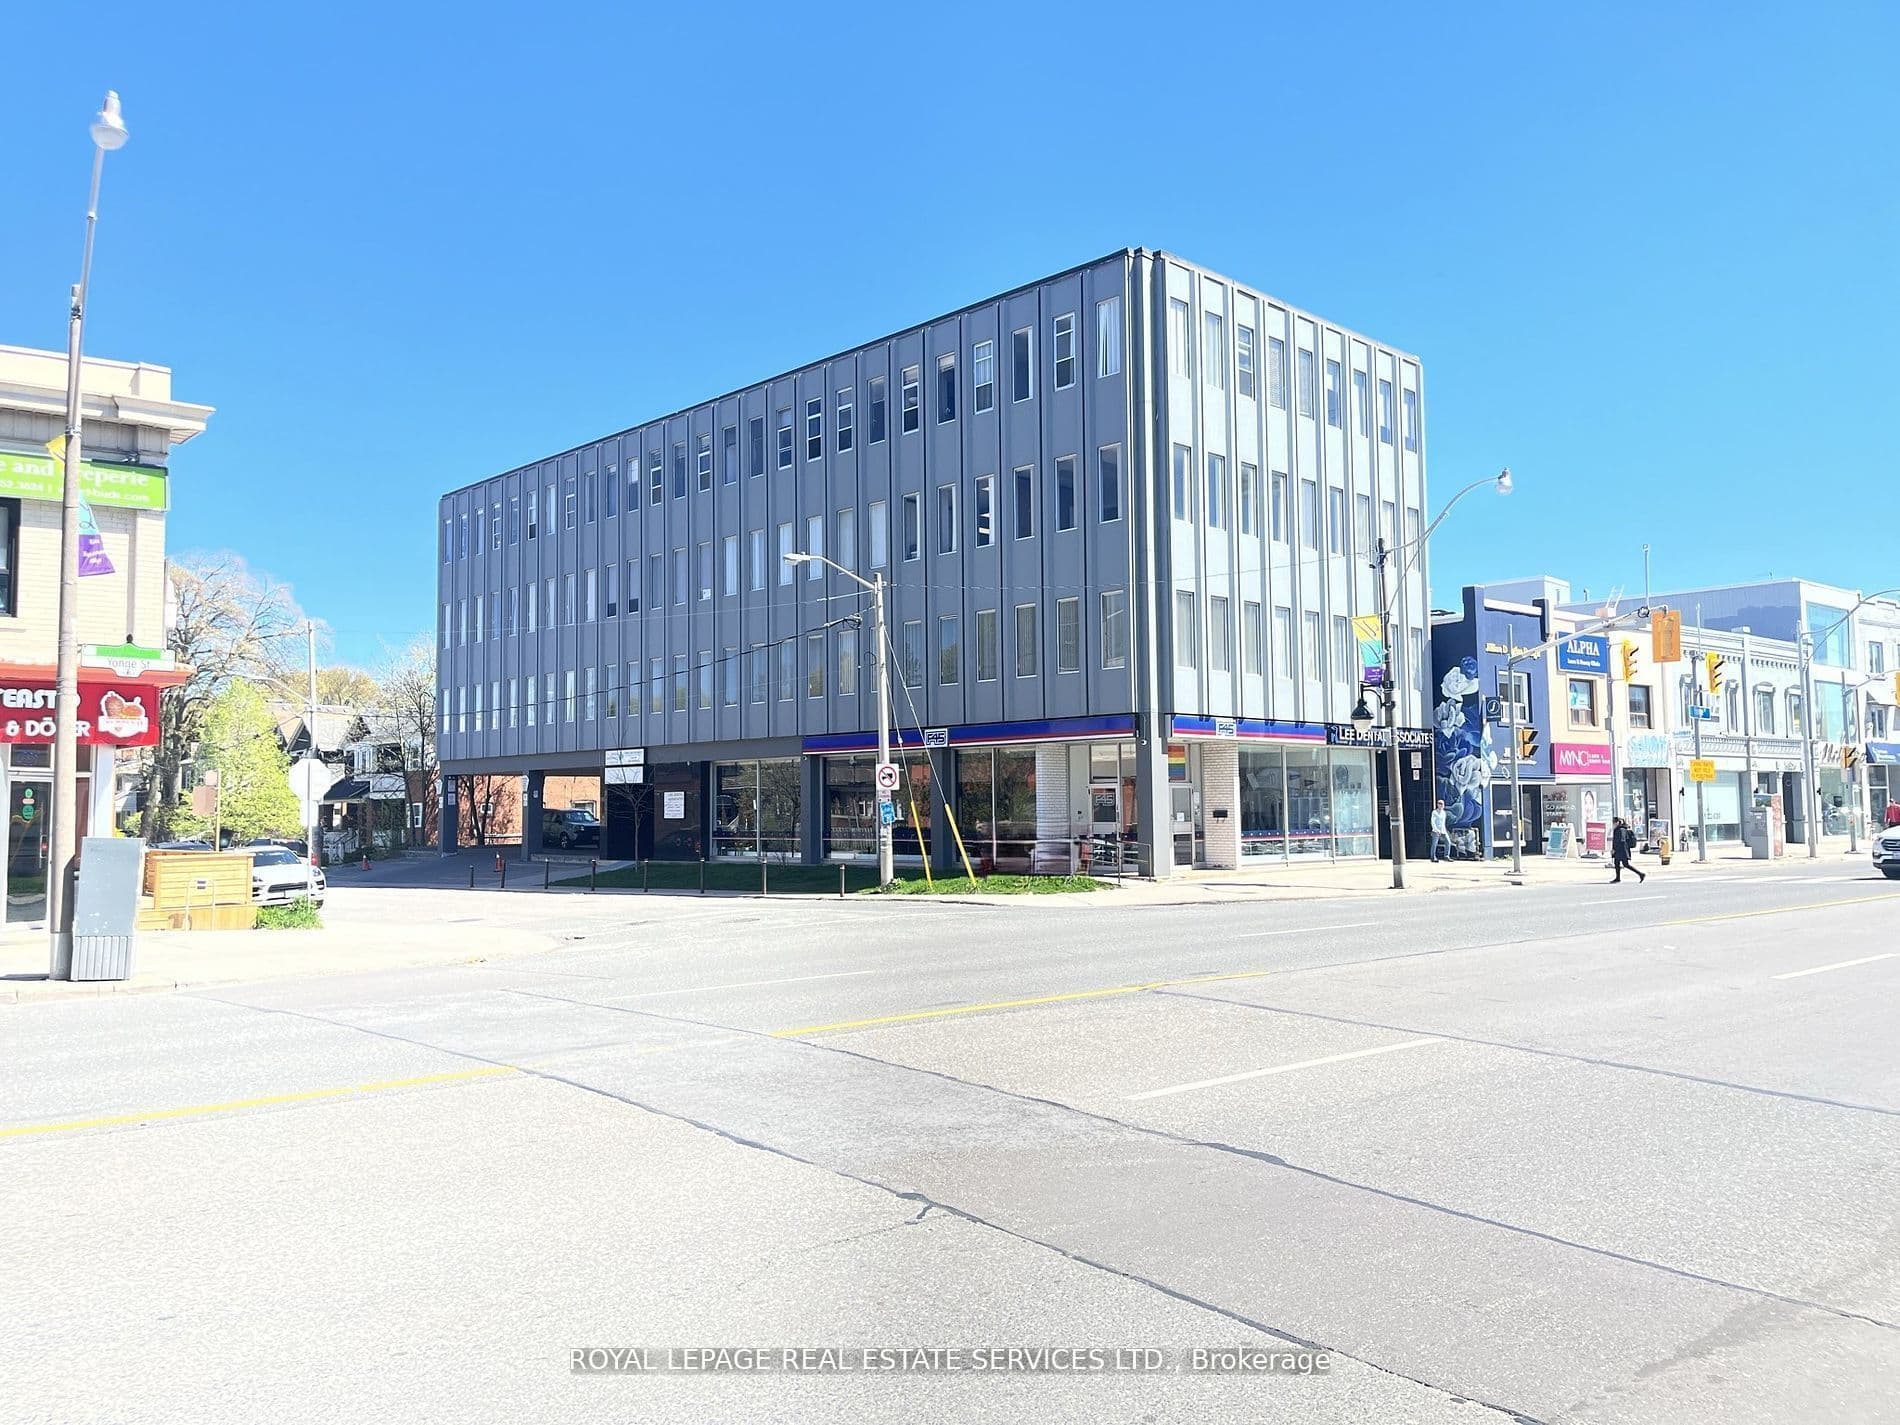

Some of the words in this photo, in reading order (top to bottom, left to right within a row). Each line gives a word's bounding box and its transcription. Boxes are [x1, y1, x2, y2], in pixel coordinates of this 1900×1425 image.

[13, 463, 54, 476] and
[1567, 640, 1600, 656] ALPHA
[107, 658, 137, 669] Yonge
[6, 720, 20, 737] &
[1339, 728, 1355, 741] LEE
[1394, 732, 1433, 744] SSOCIATES
[926, 731, 946, 746] F45
